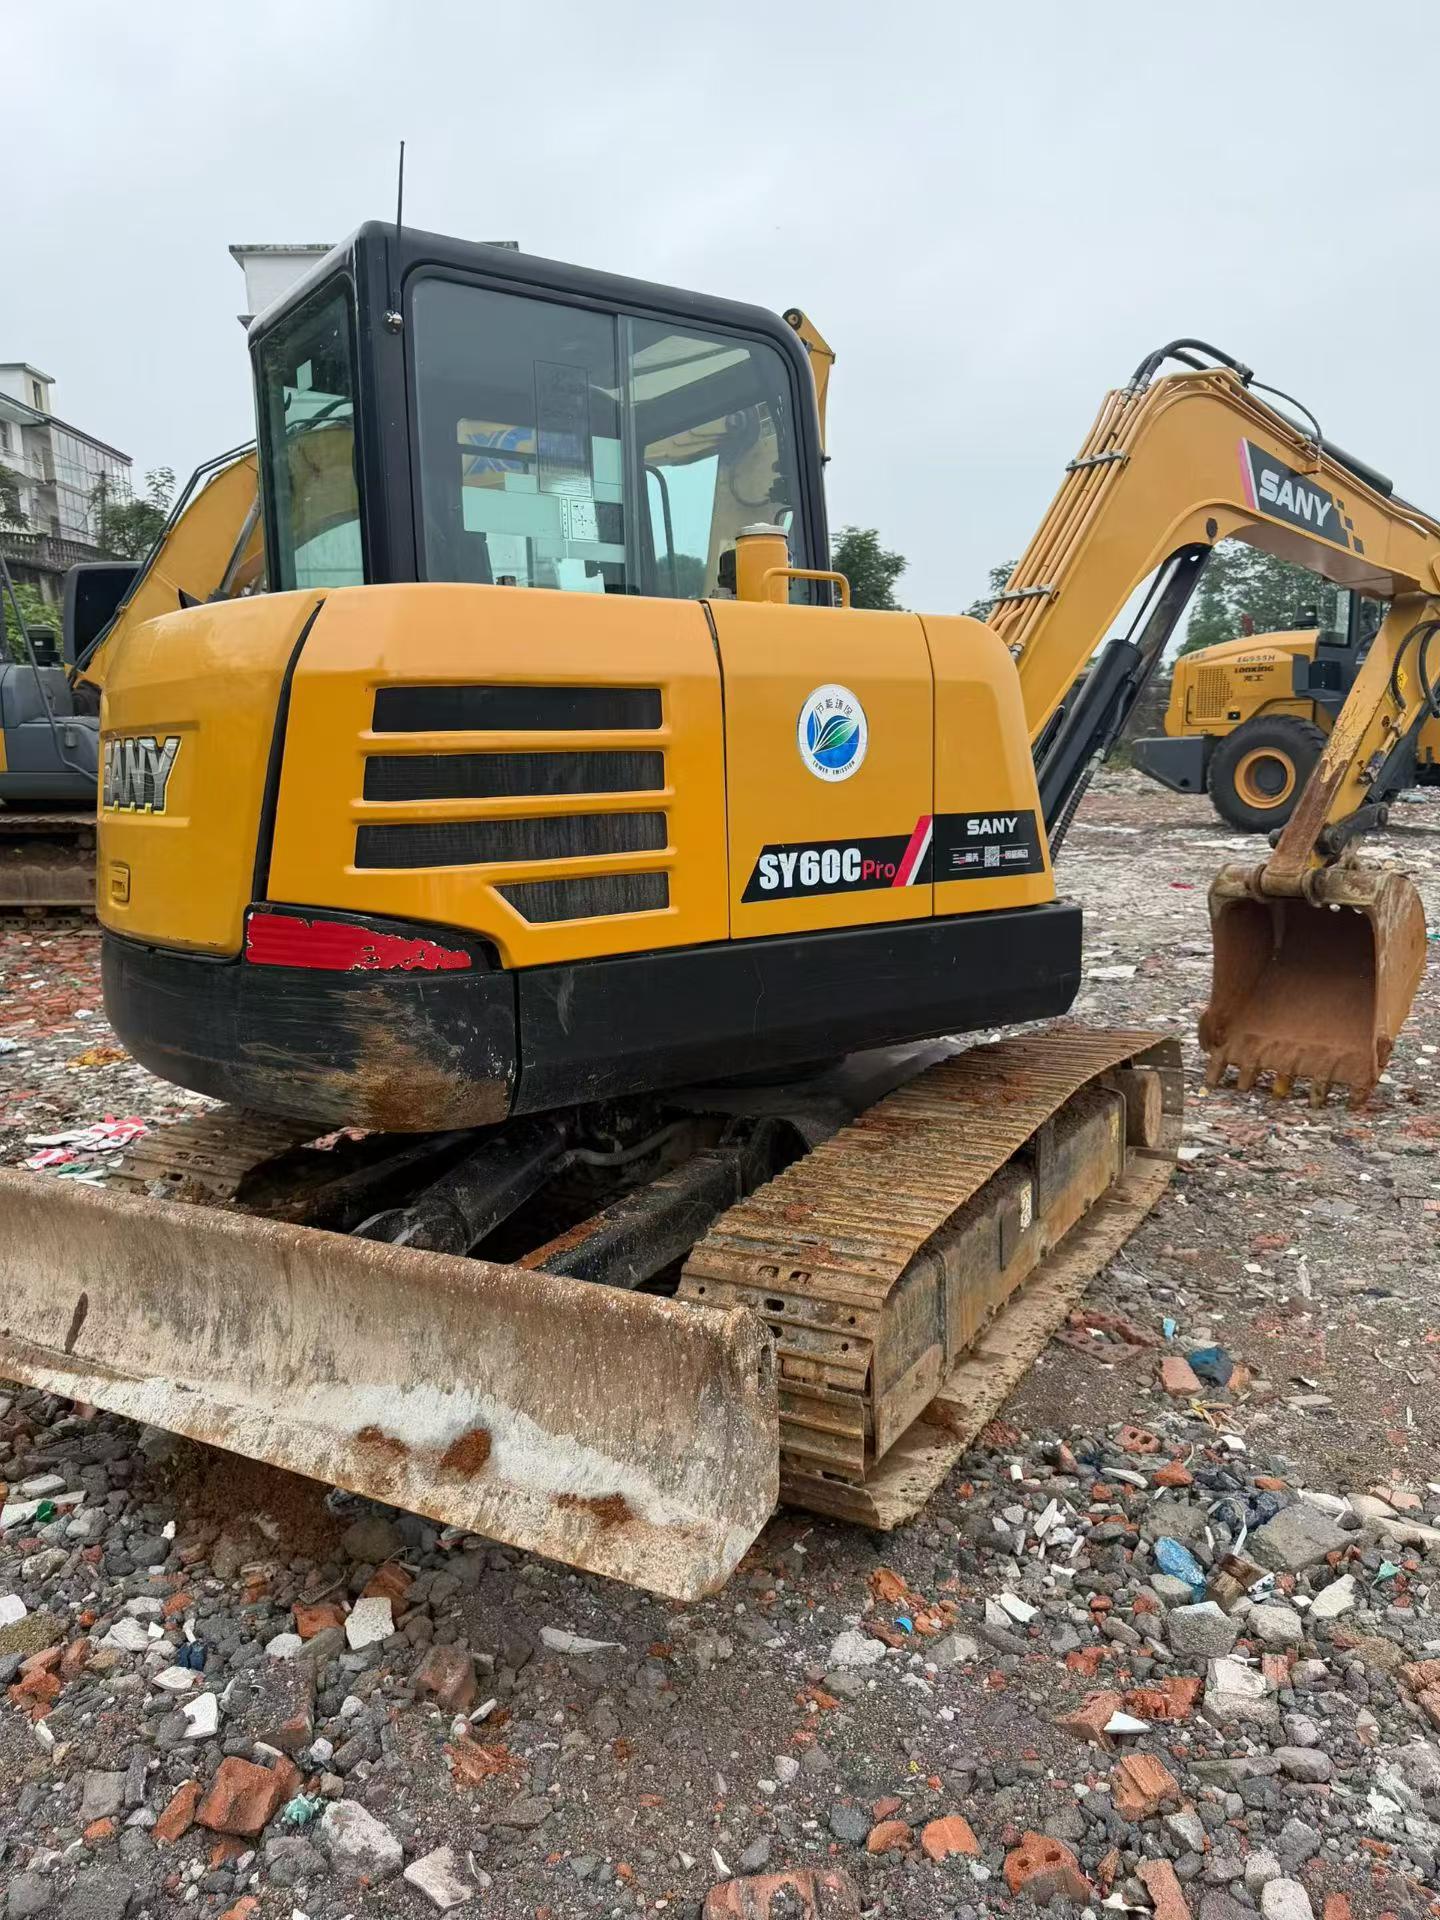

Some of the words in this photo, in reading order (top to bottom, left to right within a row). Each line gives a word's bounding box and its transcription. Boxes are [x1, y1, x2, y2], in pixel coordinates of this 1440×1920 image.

[1259, 469, 1332, 527] SANY
[832, 759, 856, 775] EMISSION
[967, 817, 1018, 836] SANY
[758, 847, 862, 890] SY60C
[862, 859, 896, 882] Pro
